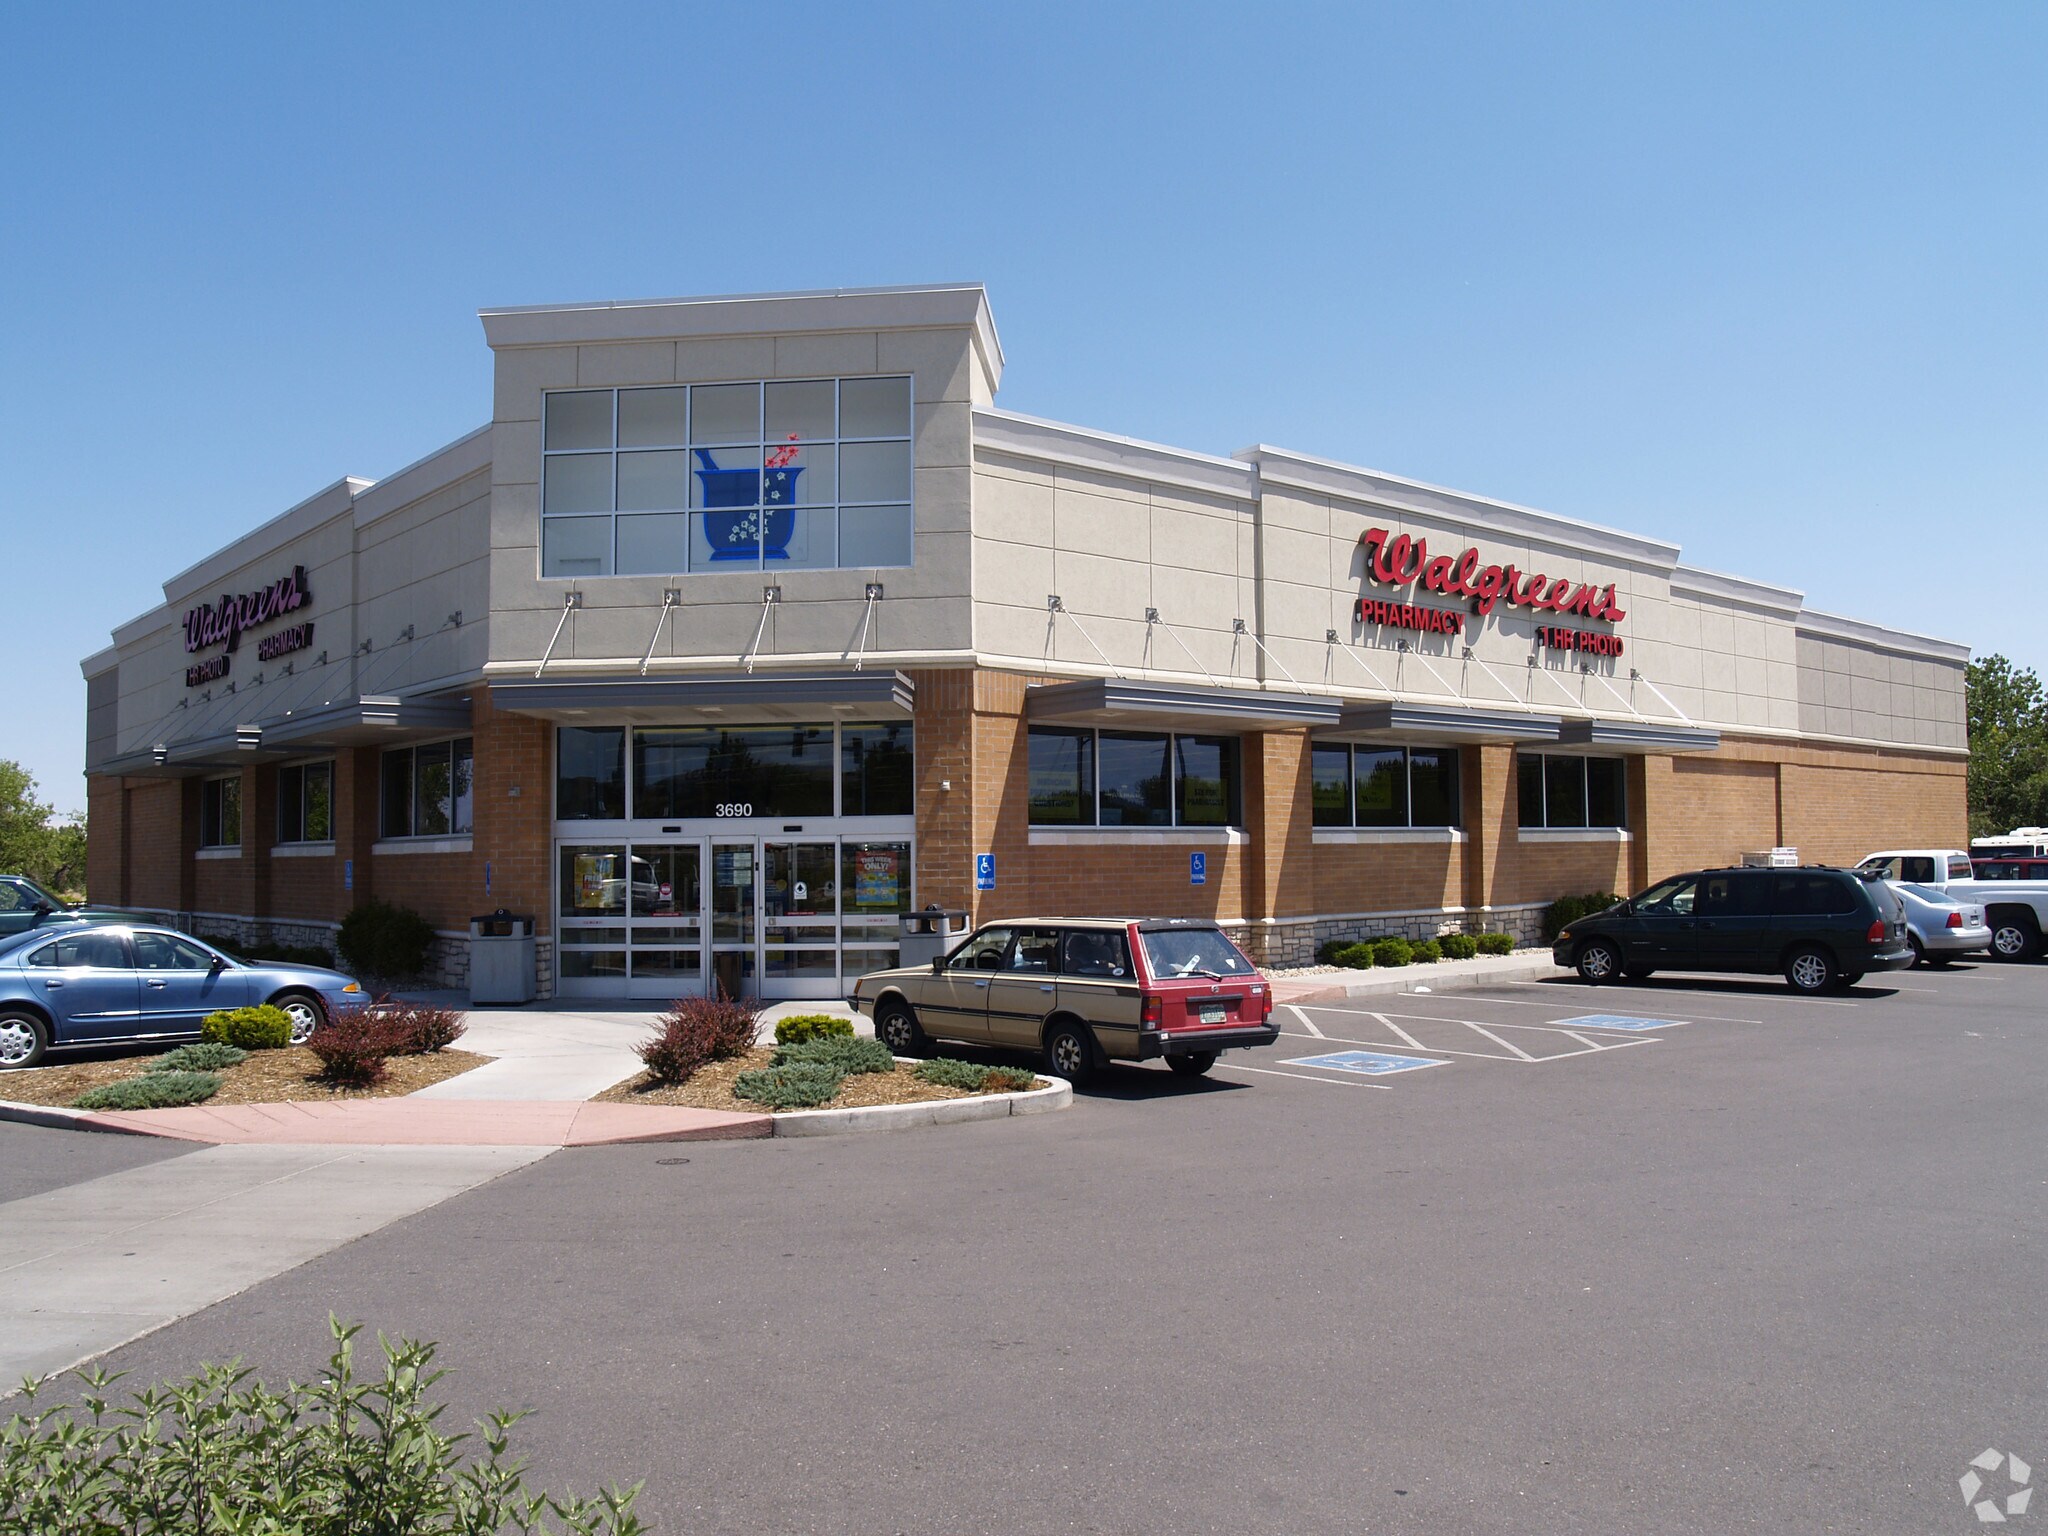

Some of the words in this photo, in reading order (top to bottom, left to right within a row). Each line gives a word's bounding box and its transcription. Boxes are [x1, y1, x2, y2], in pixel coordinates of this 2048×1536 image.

[1360, 527, 1626, 622] Walgreens
[182, 565, 308, 653] Walgreens
[1358, 598, 1466, 635] PHARMACY
[258, 623, 312, 661] PHARMACY
[1538, 625, 1549, 647] 1
[1553, 627, 1574, 649] HR
[1579, 630, 1624, 657] PHOTO
[199, 655, 228, 682] PHOTO
[715, 803, 752, 817] 3690
